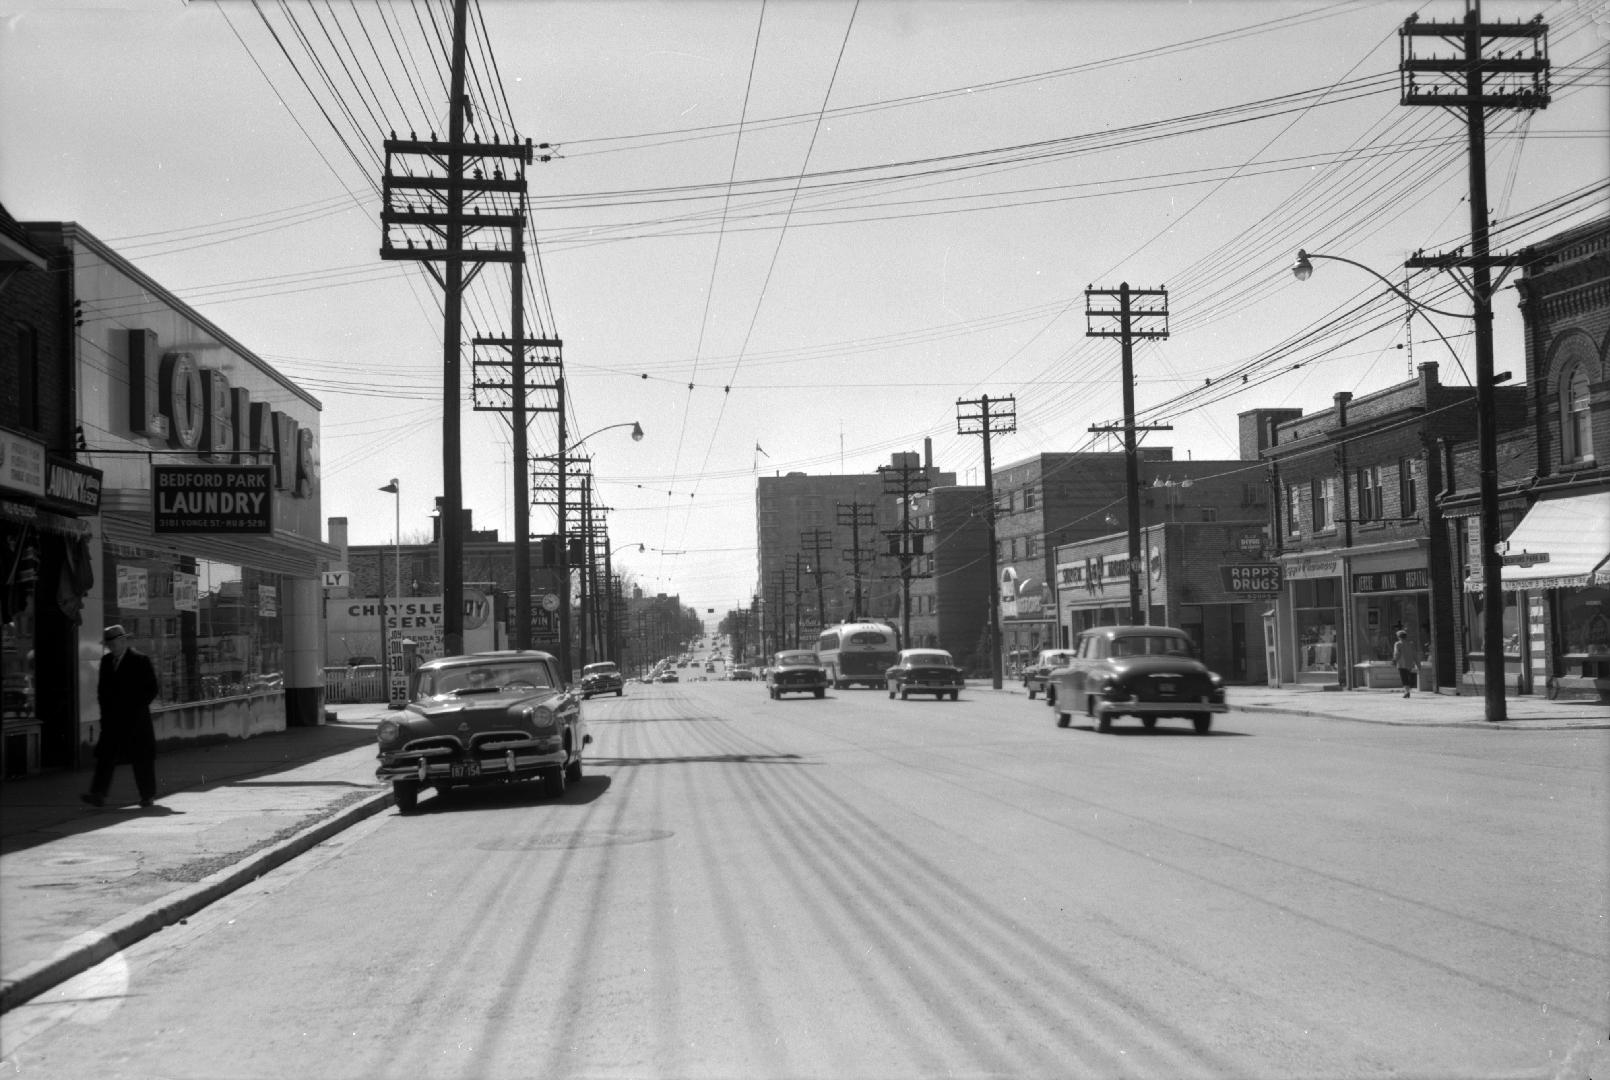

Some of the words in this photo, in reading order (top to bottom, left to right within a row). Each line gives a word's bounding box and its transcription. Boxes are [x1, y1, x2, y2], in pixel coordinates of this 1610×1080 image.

[129, 327, 314, 500] LOBLAWS
[159, 473, 223, 487] BEDFORD
[226, 473, 266, 487] PARK
[159, 491, 265, 514] LAUNDRY
[181, 519, 208, 528] YONGE
[326, 574, 342, 586] LY
[1232, 567, 1280, 579] RAPP'S
[1232, 578, 1280, 592] DRUGS
[348, 603, 442, 617] CHRYSLE
[463, 600, 486, 618] OY
[391, 687, 406, 700] 35
